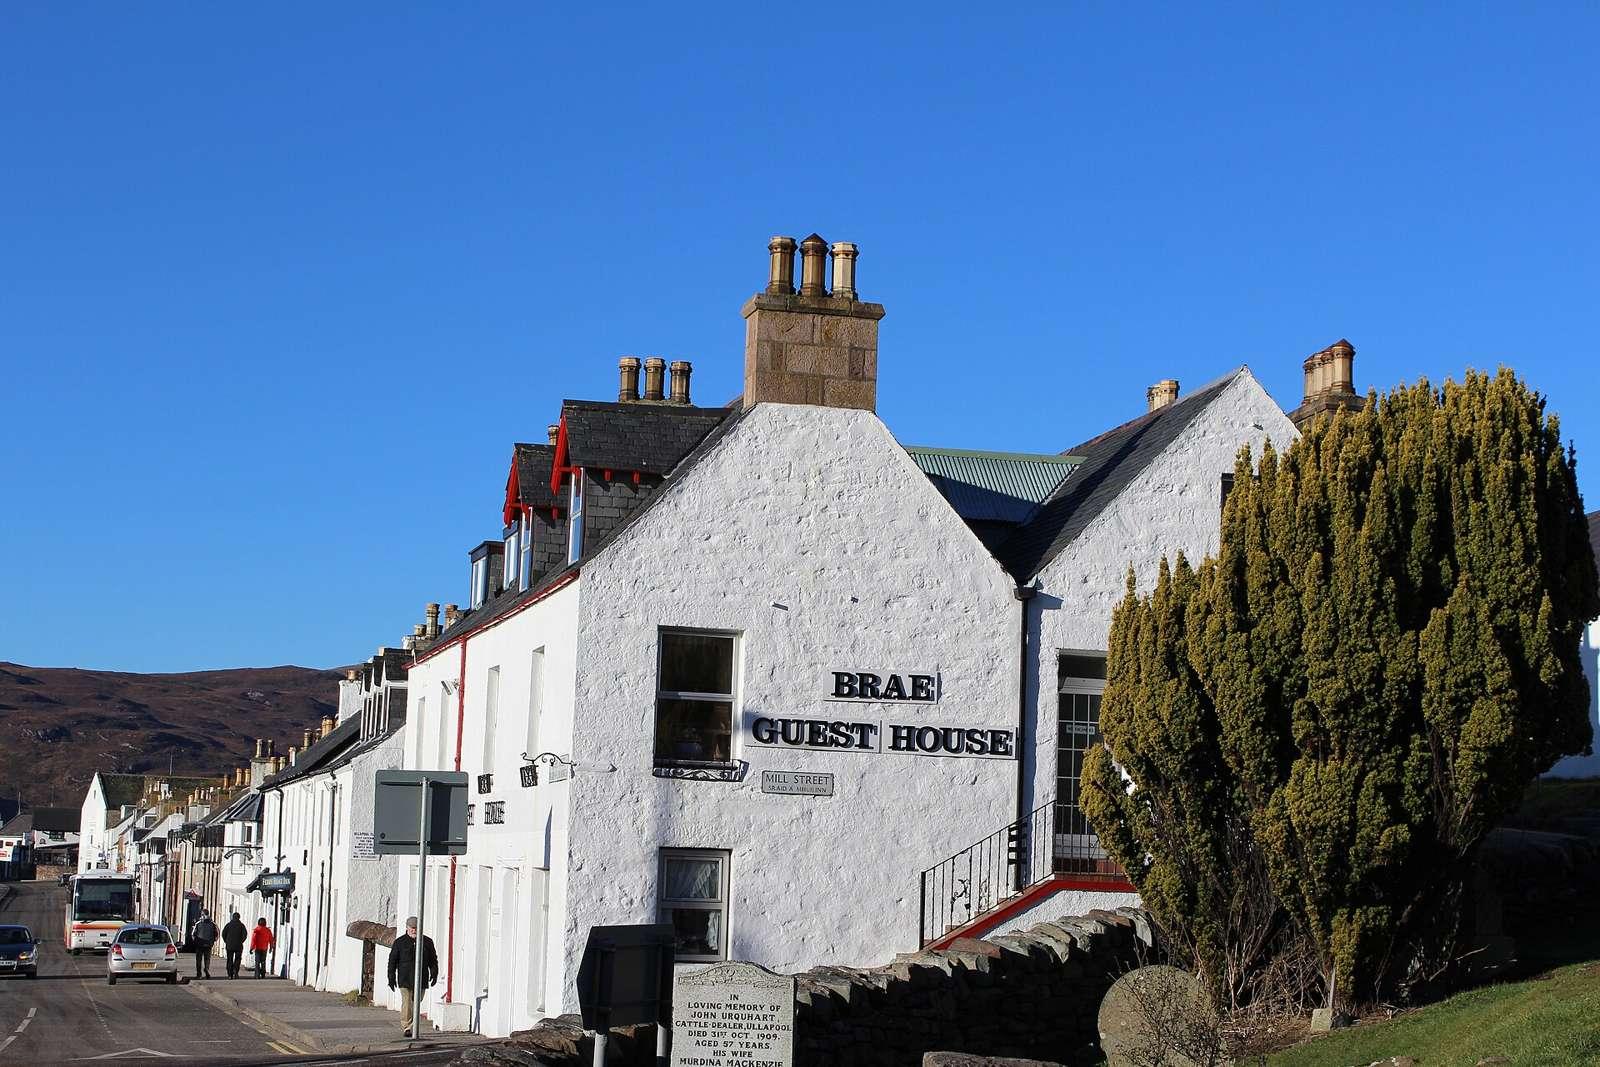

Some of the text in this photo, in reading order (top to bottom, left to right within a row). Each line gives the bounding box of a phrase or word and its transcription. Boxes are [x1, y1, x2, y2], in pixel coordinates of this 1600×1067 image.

[831, 671, 935, 701] BRAE
[752, 717, 1013, 756] GUEST HOUSE
[765, 774, 830, 785] MILL STREET
[688, 1002, 722, 1010] LOVING
[725, 1003, 765, 1012] MEMORY
[691, 1011, 717, 1019] JOHN
[688, 1030, 707, 1038] DIED
[694, 1040, 719, 1048] AGED
[731, 1050, 753, 1058] WIFE
[680, 1058, 721, 1067] MURDINA
